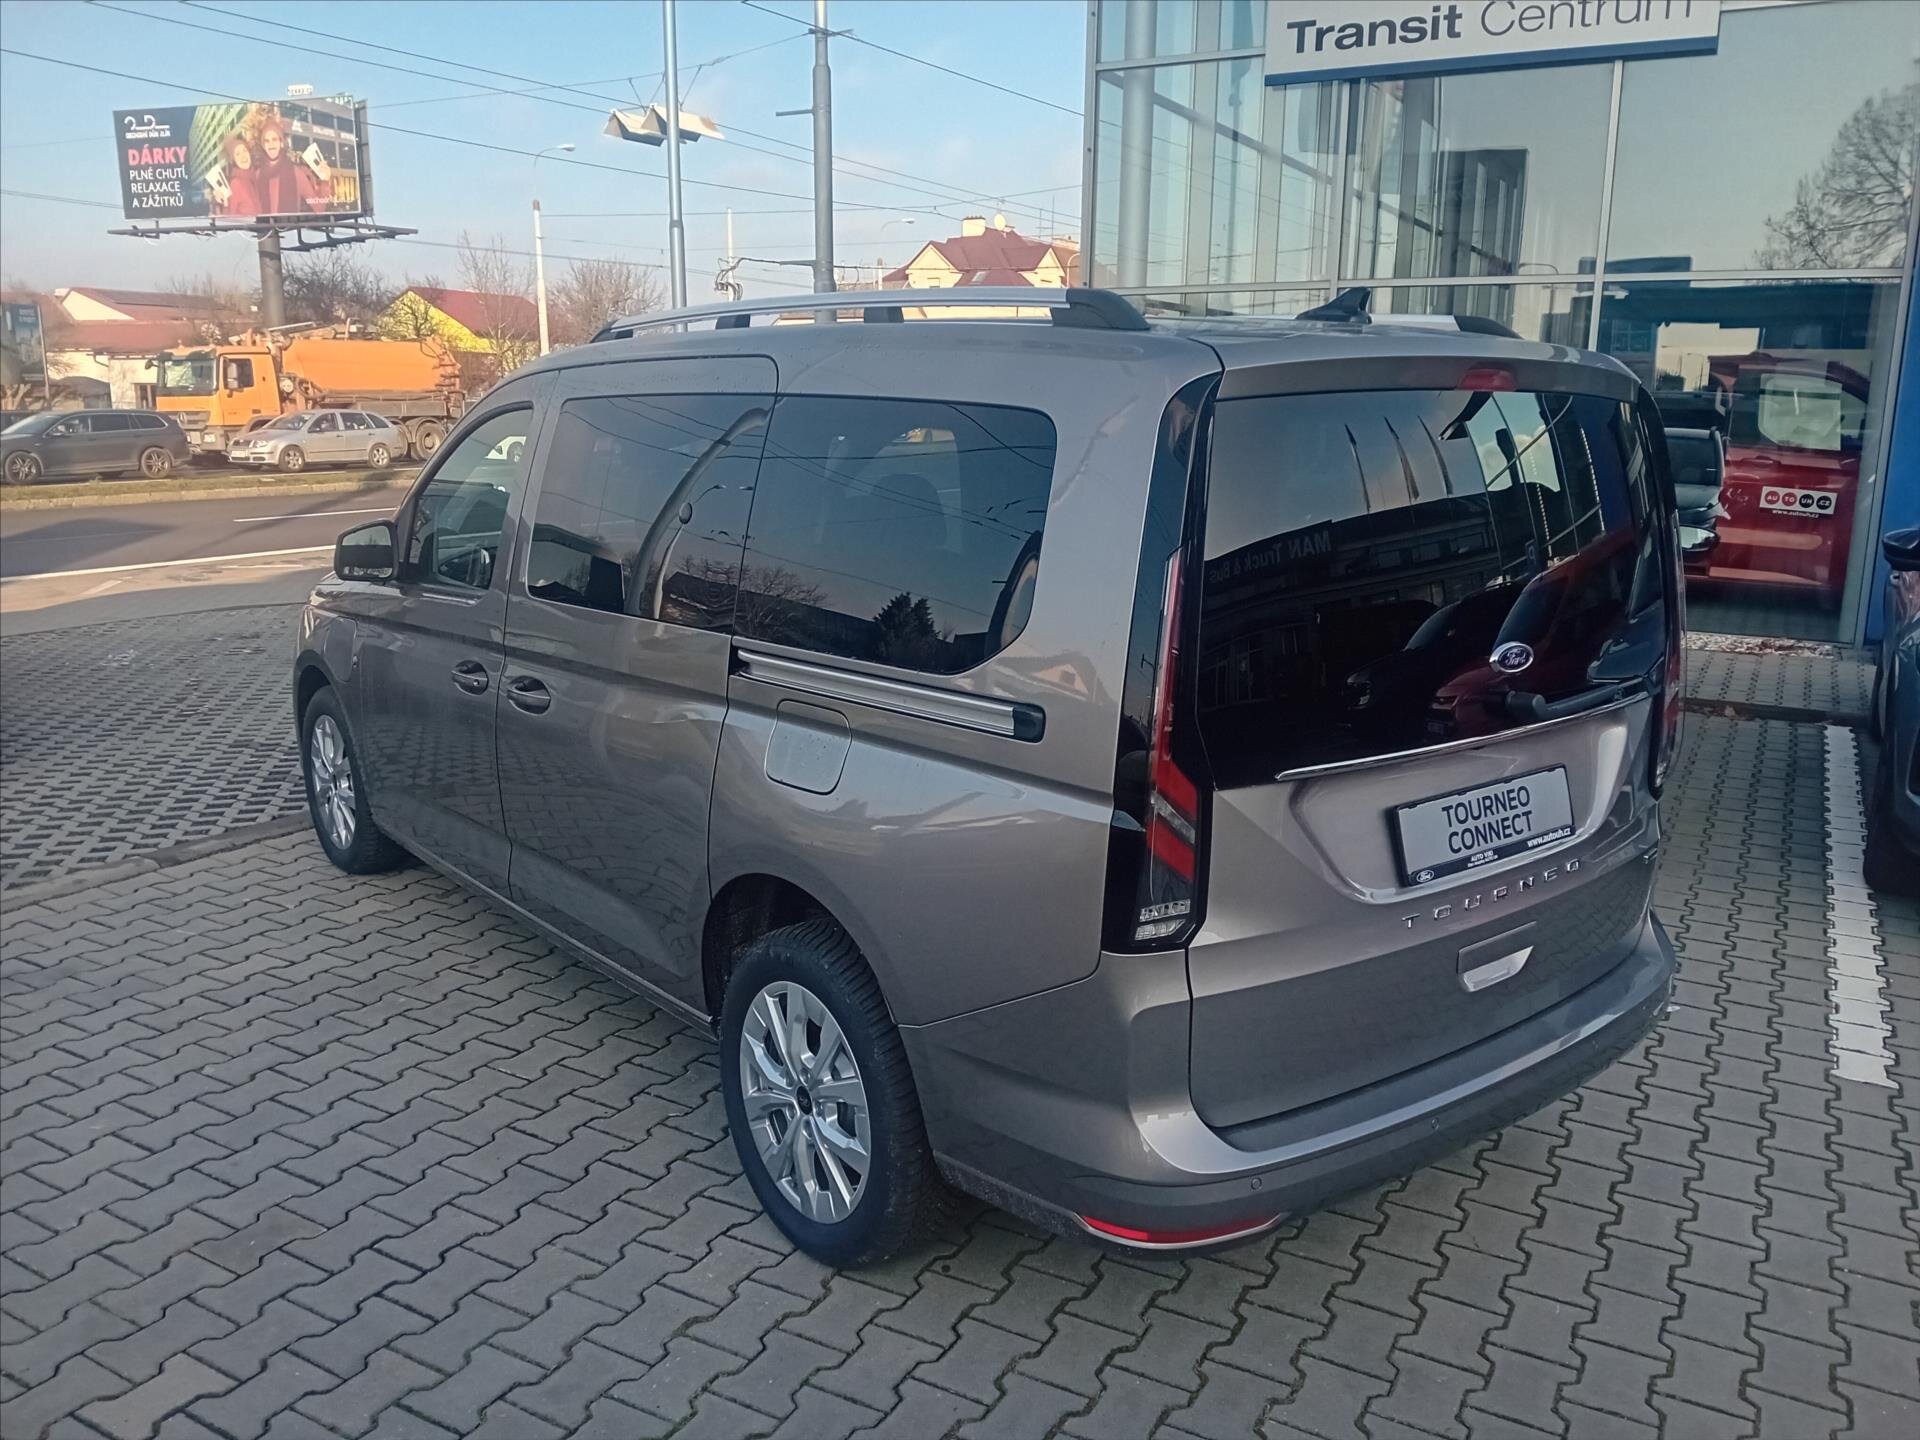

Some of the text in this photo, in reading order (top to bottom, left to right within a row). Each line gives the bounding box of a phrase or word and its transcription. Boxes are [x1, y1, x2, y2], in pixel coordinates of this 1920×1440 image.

[1287, 5, 1463, 54] Transit
[128, 144, 187, 166] DÁRKY
[130, 165, 188, 180] PLNÉ CHUTÍ,
[131, 181, 181, 193] RELAXACE
[132, 193, 184, 208] A ZÁŽITKŮ
[1441, 785, 1531, 827] TOURNEO
[1448, 810, 1533, 854] CONNECT
[1402, 858, 1580, 928] TOURNEO
